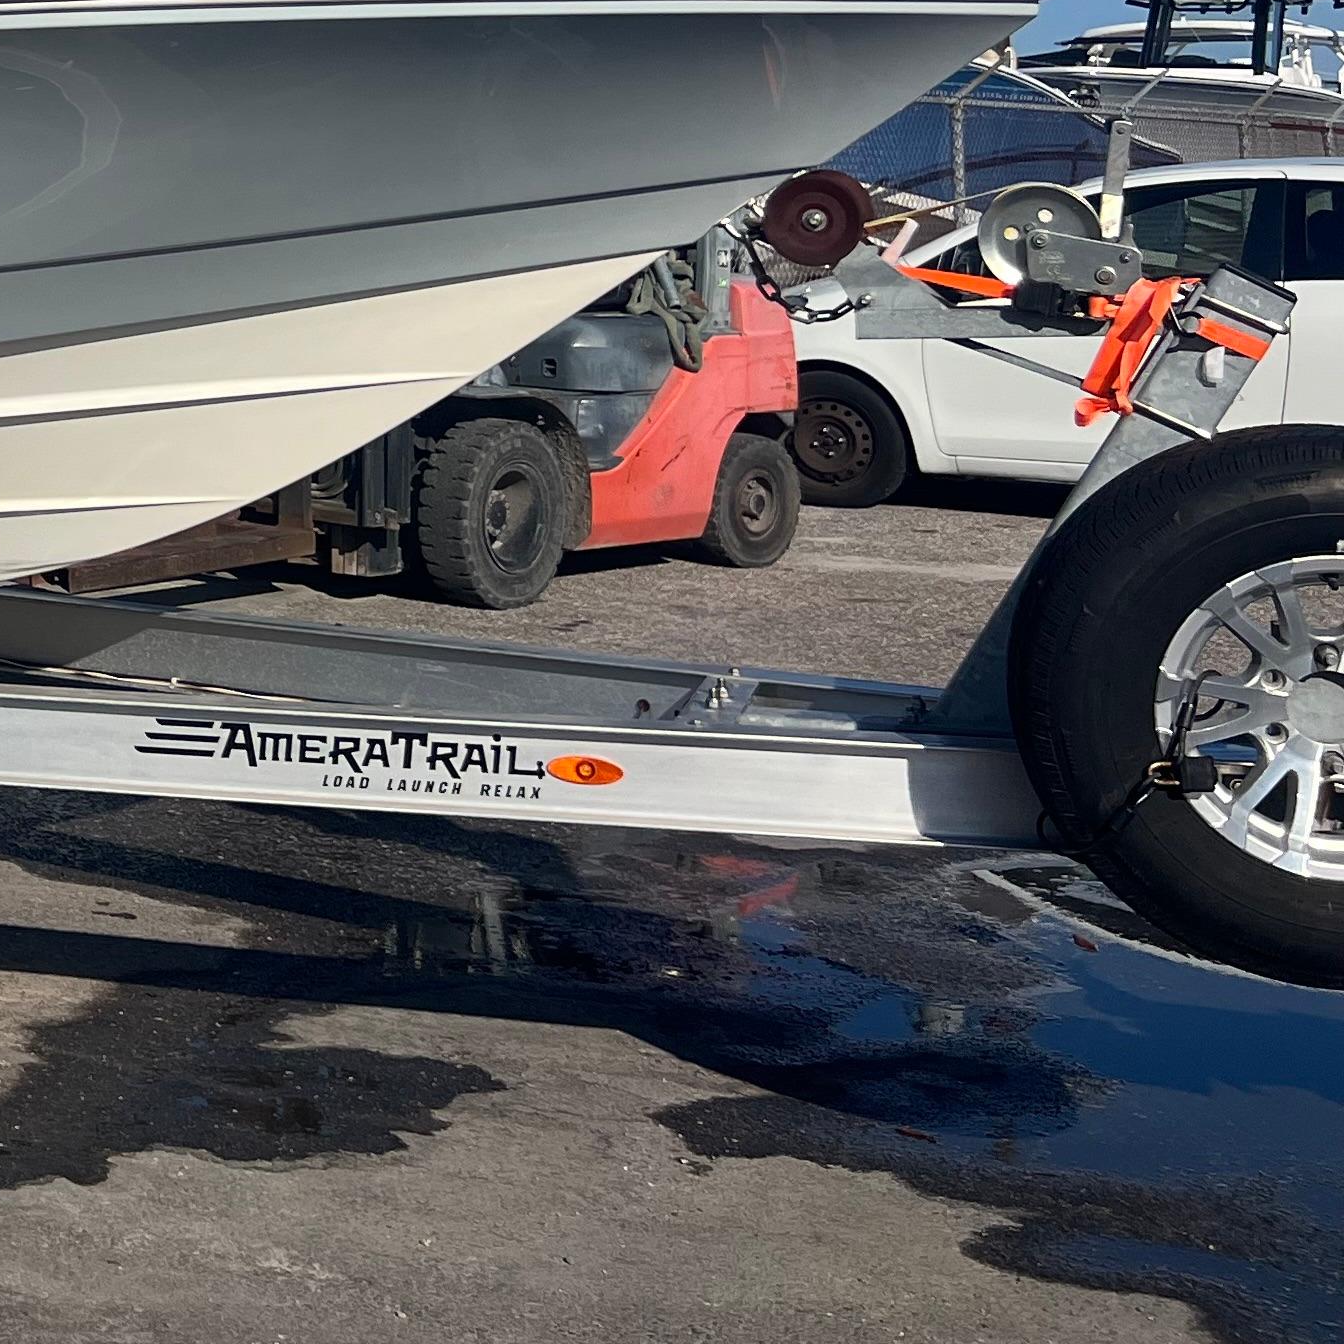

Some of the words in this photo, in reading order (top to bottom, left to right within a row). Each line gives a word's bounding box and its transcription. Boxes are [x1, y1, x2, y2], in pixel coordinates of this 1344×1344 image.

[322, 774, 370, 790] LOAD
[387, 778, 463, 796] LAUNCH
[480, 784, 542, 800] RELAX
